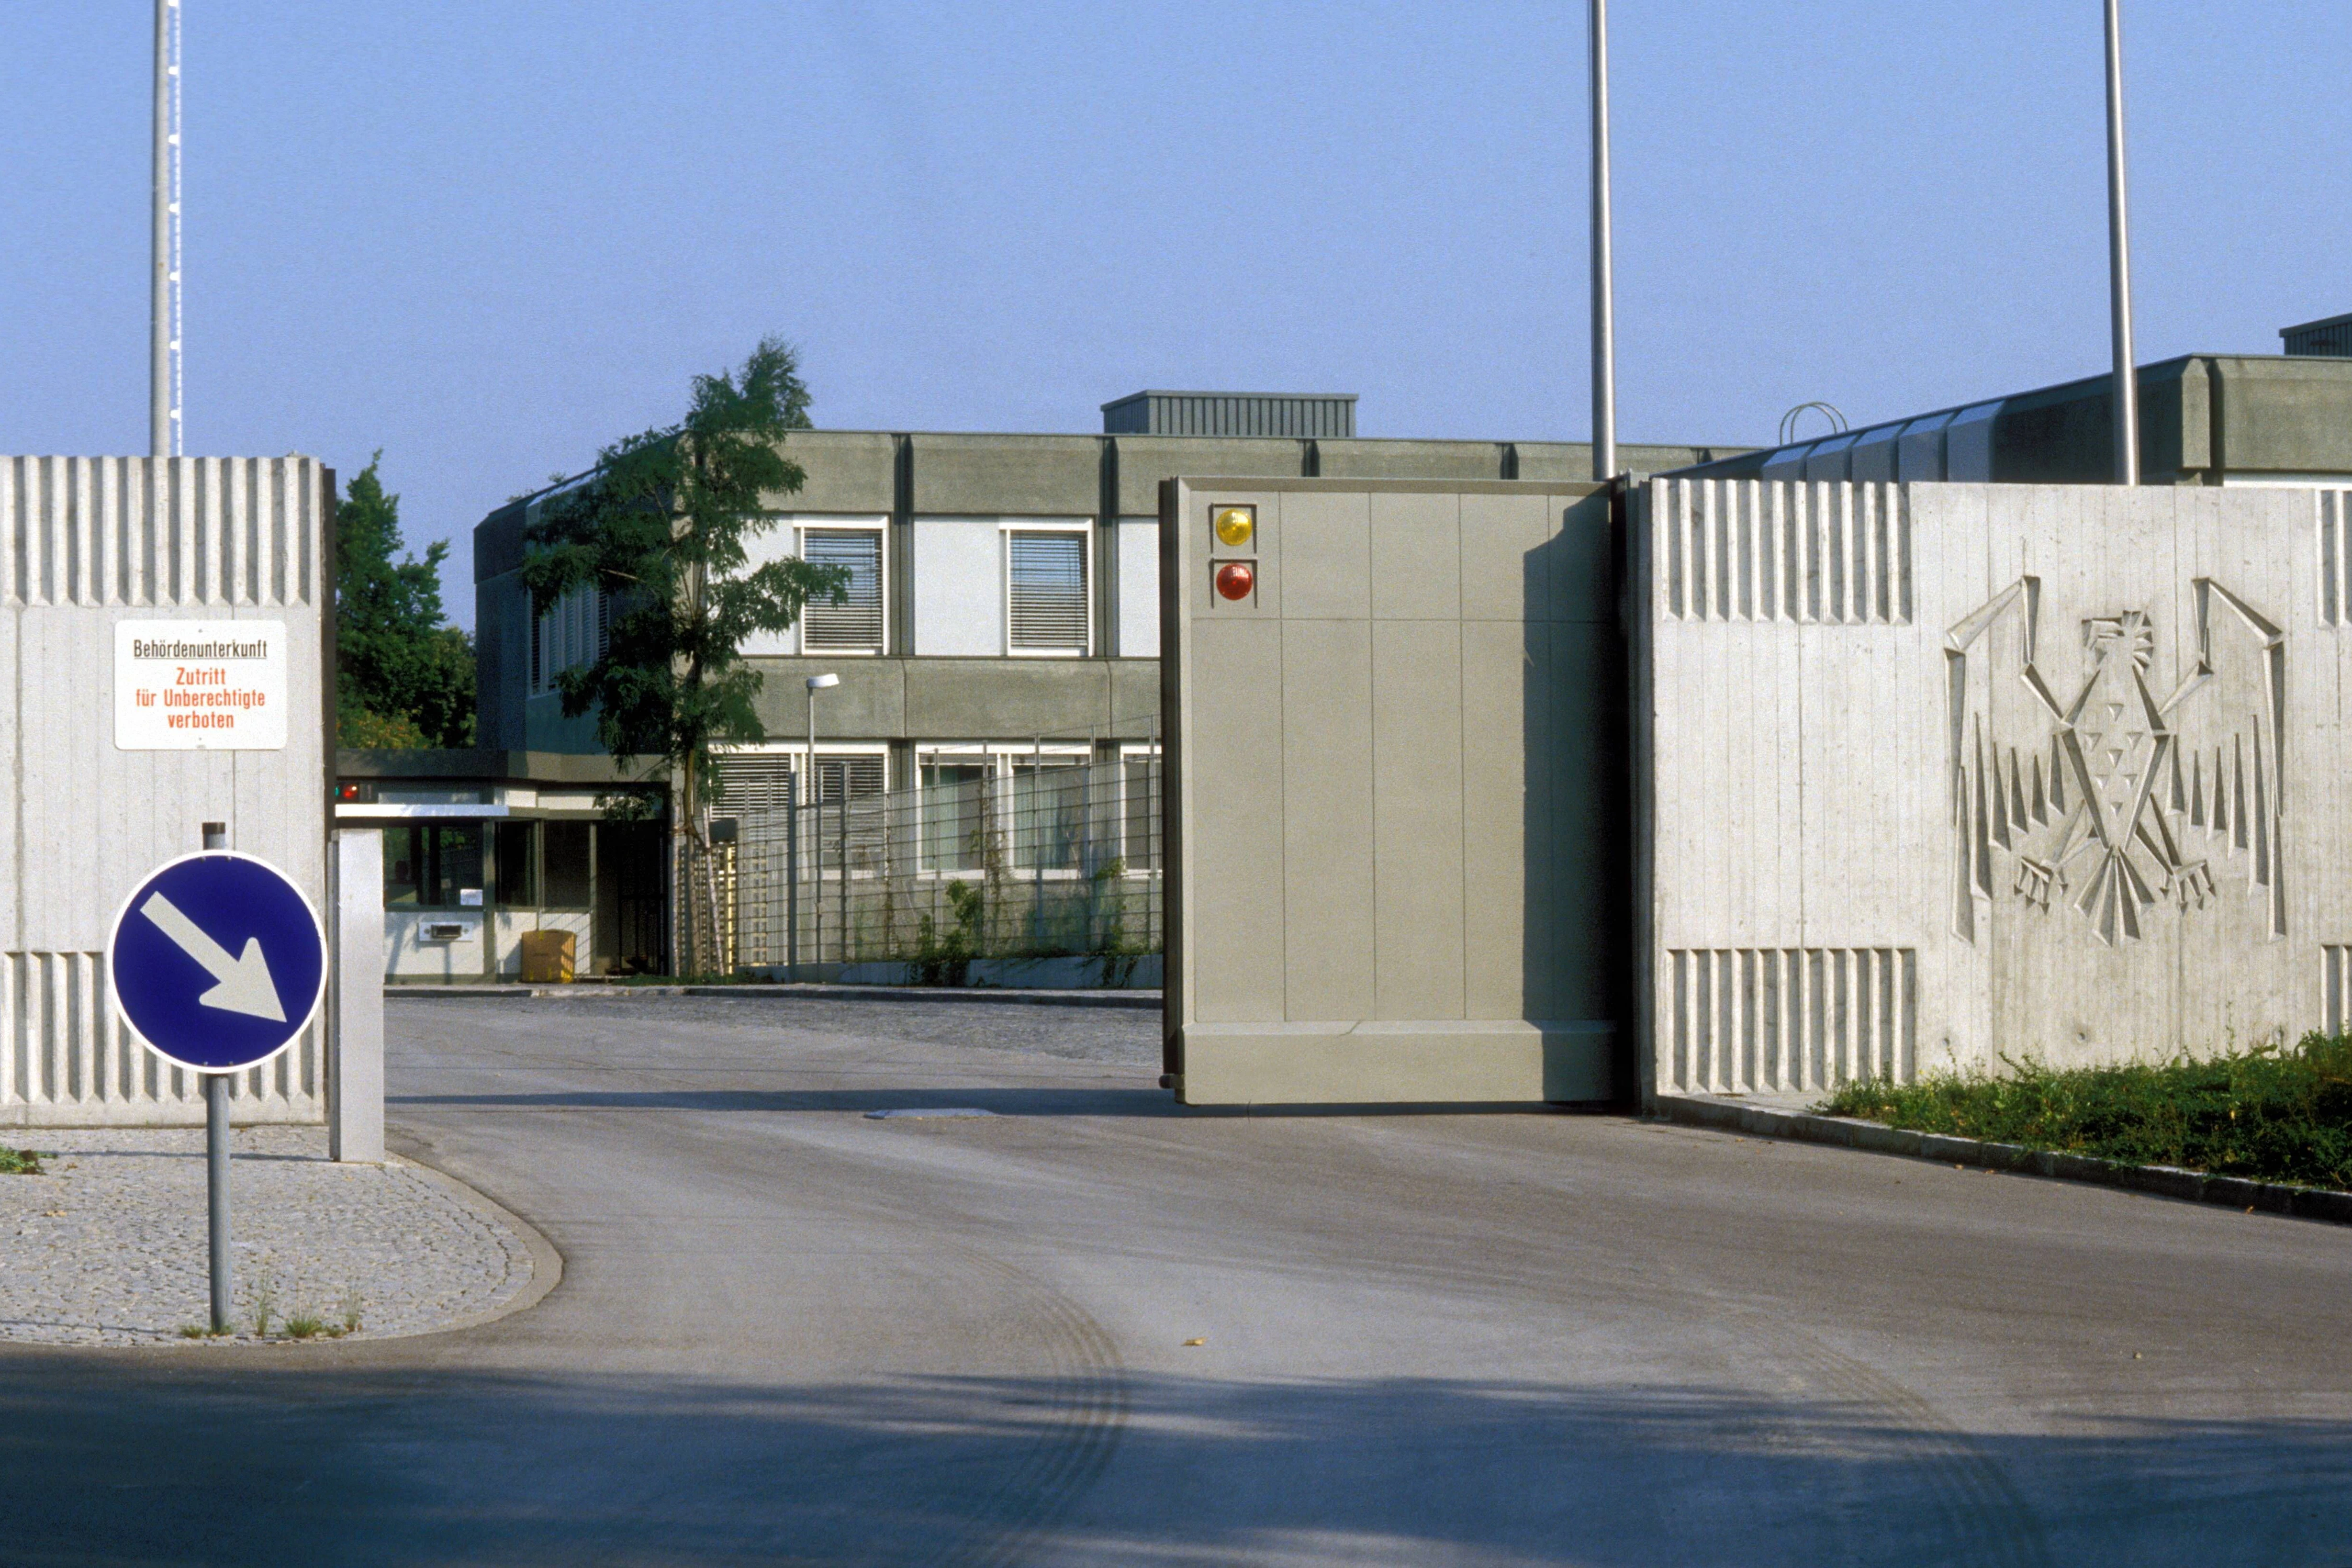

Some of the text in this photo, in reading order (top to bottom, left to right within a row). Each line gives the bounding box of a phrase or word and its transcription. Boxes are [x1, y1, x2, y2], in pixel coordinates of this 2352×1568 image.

[134, 639, 267, 658] Behördenunterkunft
[176, 667, 225, 685] Zutritt
[136, 688, 265, 709] für Unberechtigte
[168, 710, 234, 728] verboten
